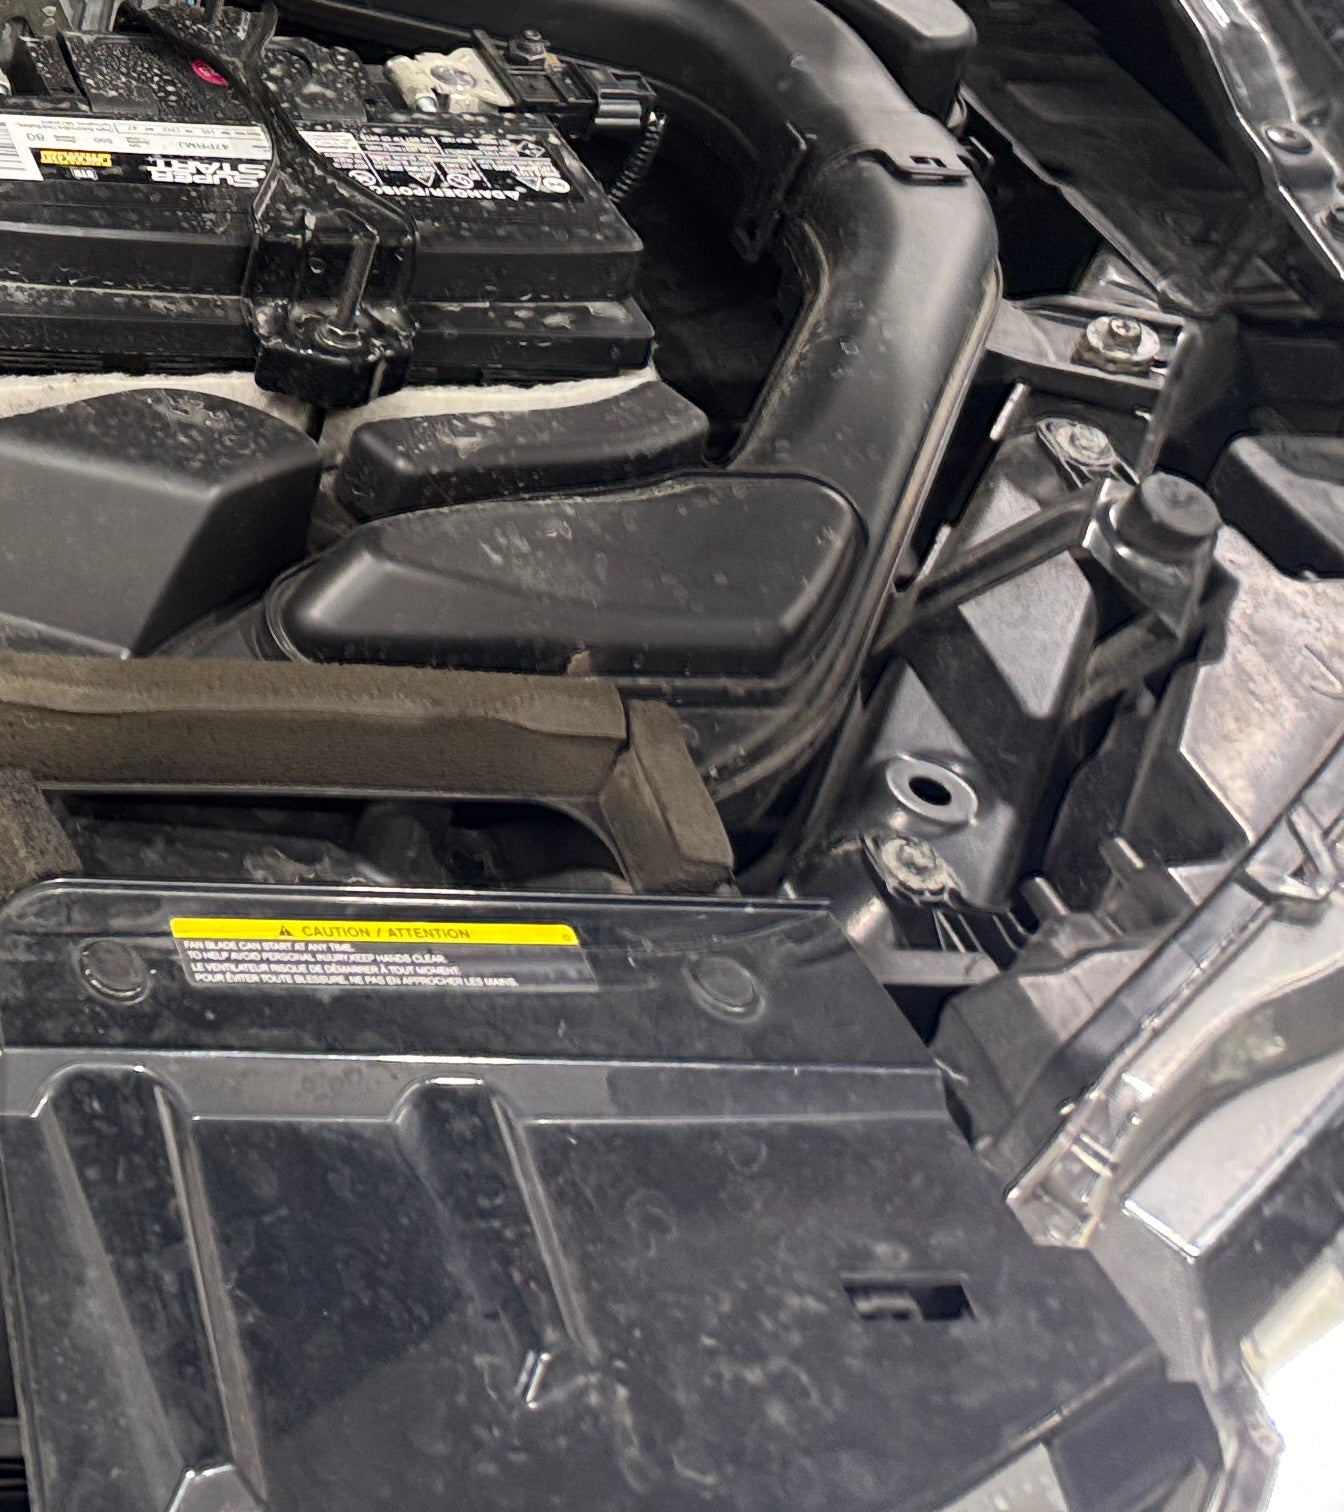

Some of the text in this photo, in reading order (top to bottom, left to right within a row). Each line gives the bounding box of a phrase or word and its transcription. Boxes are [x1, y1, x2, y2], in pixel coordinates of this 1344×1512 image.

[148, 159, 266, 178] START
[152, 170, 260, 188] SUPER
[301, 925, 371, 938] CAUTION
[387, 927, 471, 939] ATTENTION
[262, 941, 292, 950] START
[203, 951, 230, 960] HELP
[231, 951, 261, 961] AVOID
[261, 952, 315, 961] PERSONAL
[375, 953, 411, 963] HANDS
[389, 965, 414, 975] TOUT
